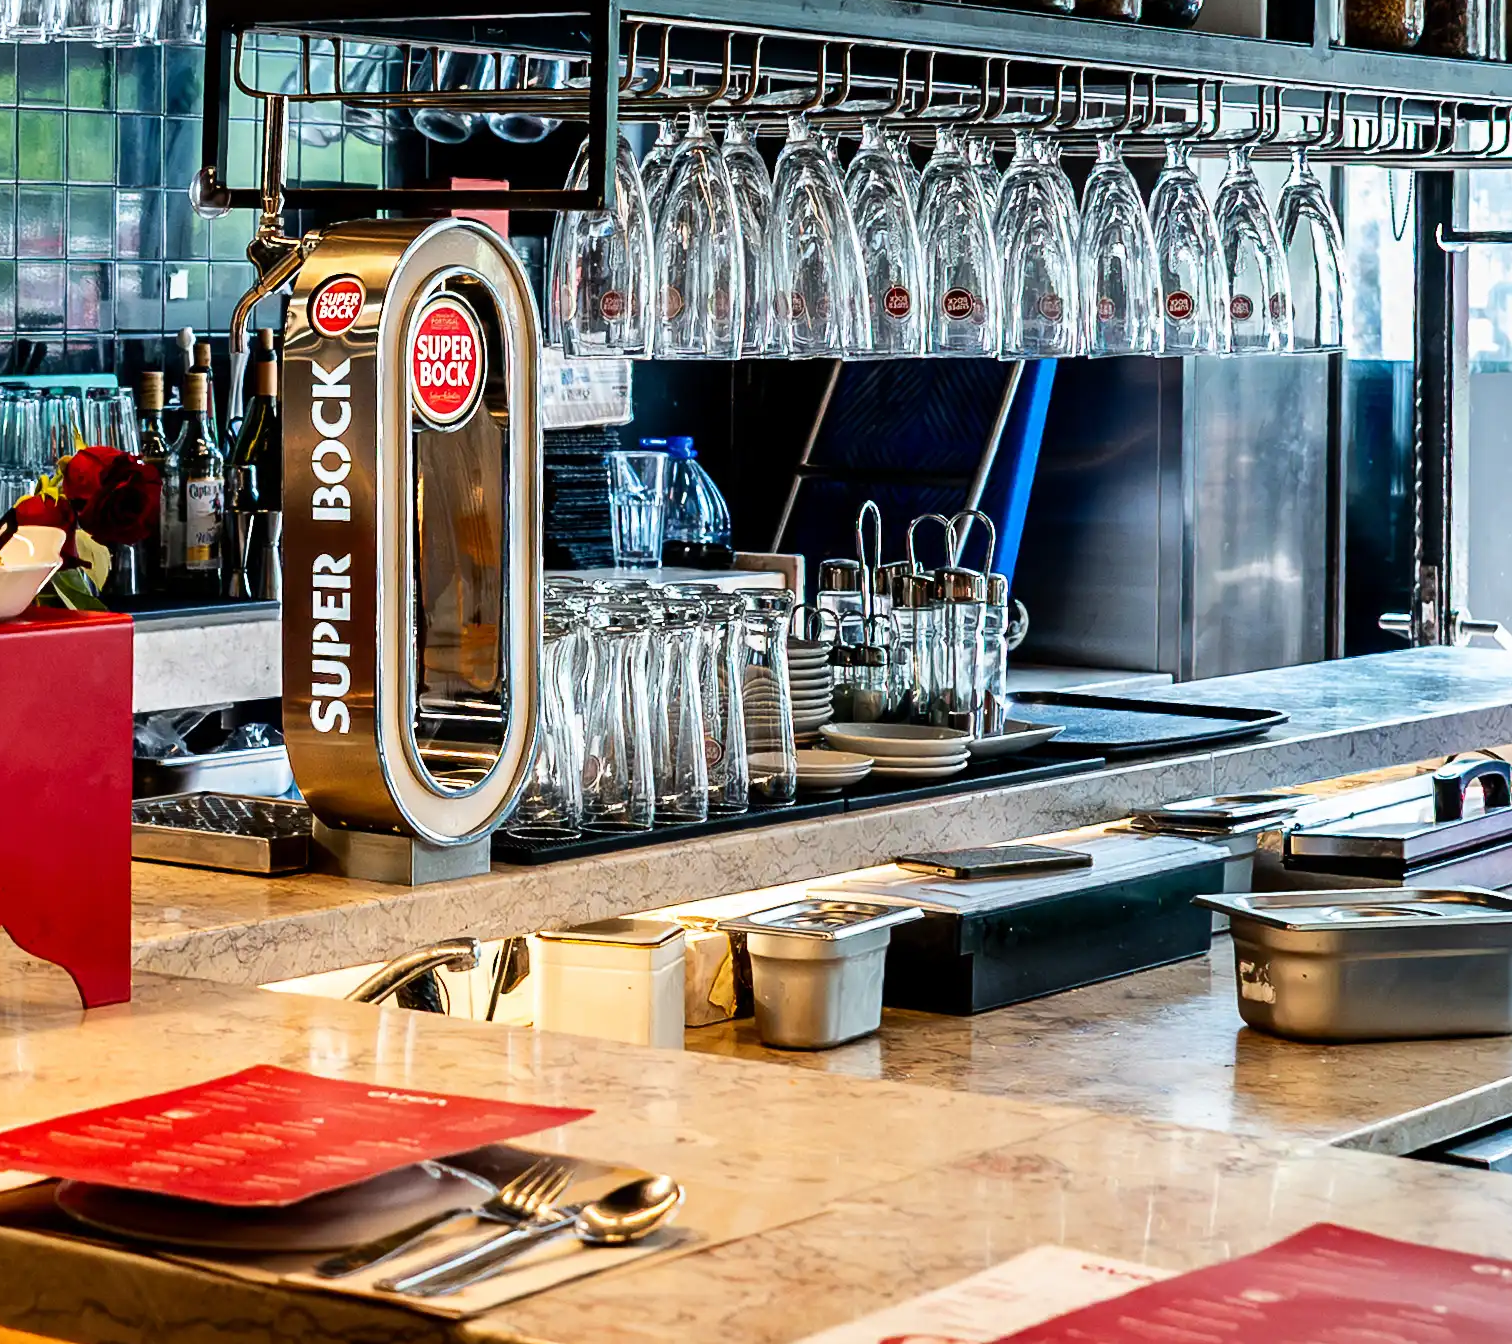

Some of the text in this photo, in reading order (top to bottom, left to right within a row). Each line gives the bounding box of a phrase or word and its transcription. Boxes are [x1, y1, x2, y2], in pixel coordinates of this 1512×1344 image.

[318, 304, 356, 320] BOCK
[319, 292, 361, 307] SUPER
[416, 334, 473, 361] SUPER
[419, 360, 470, 387] BOCK
[310, 357, 352, 736] SUPER BOCK
